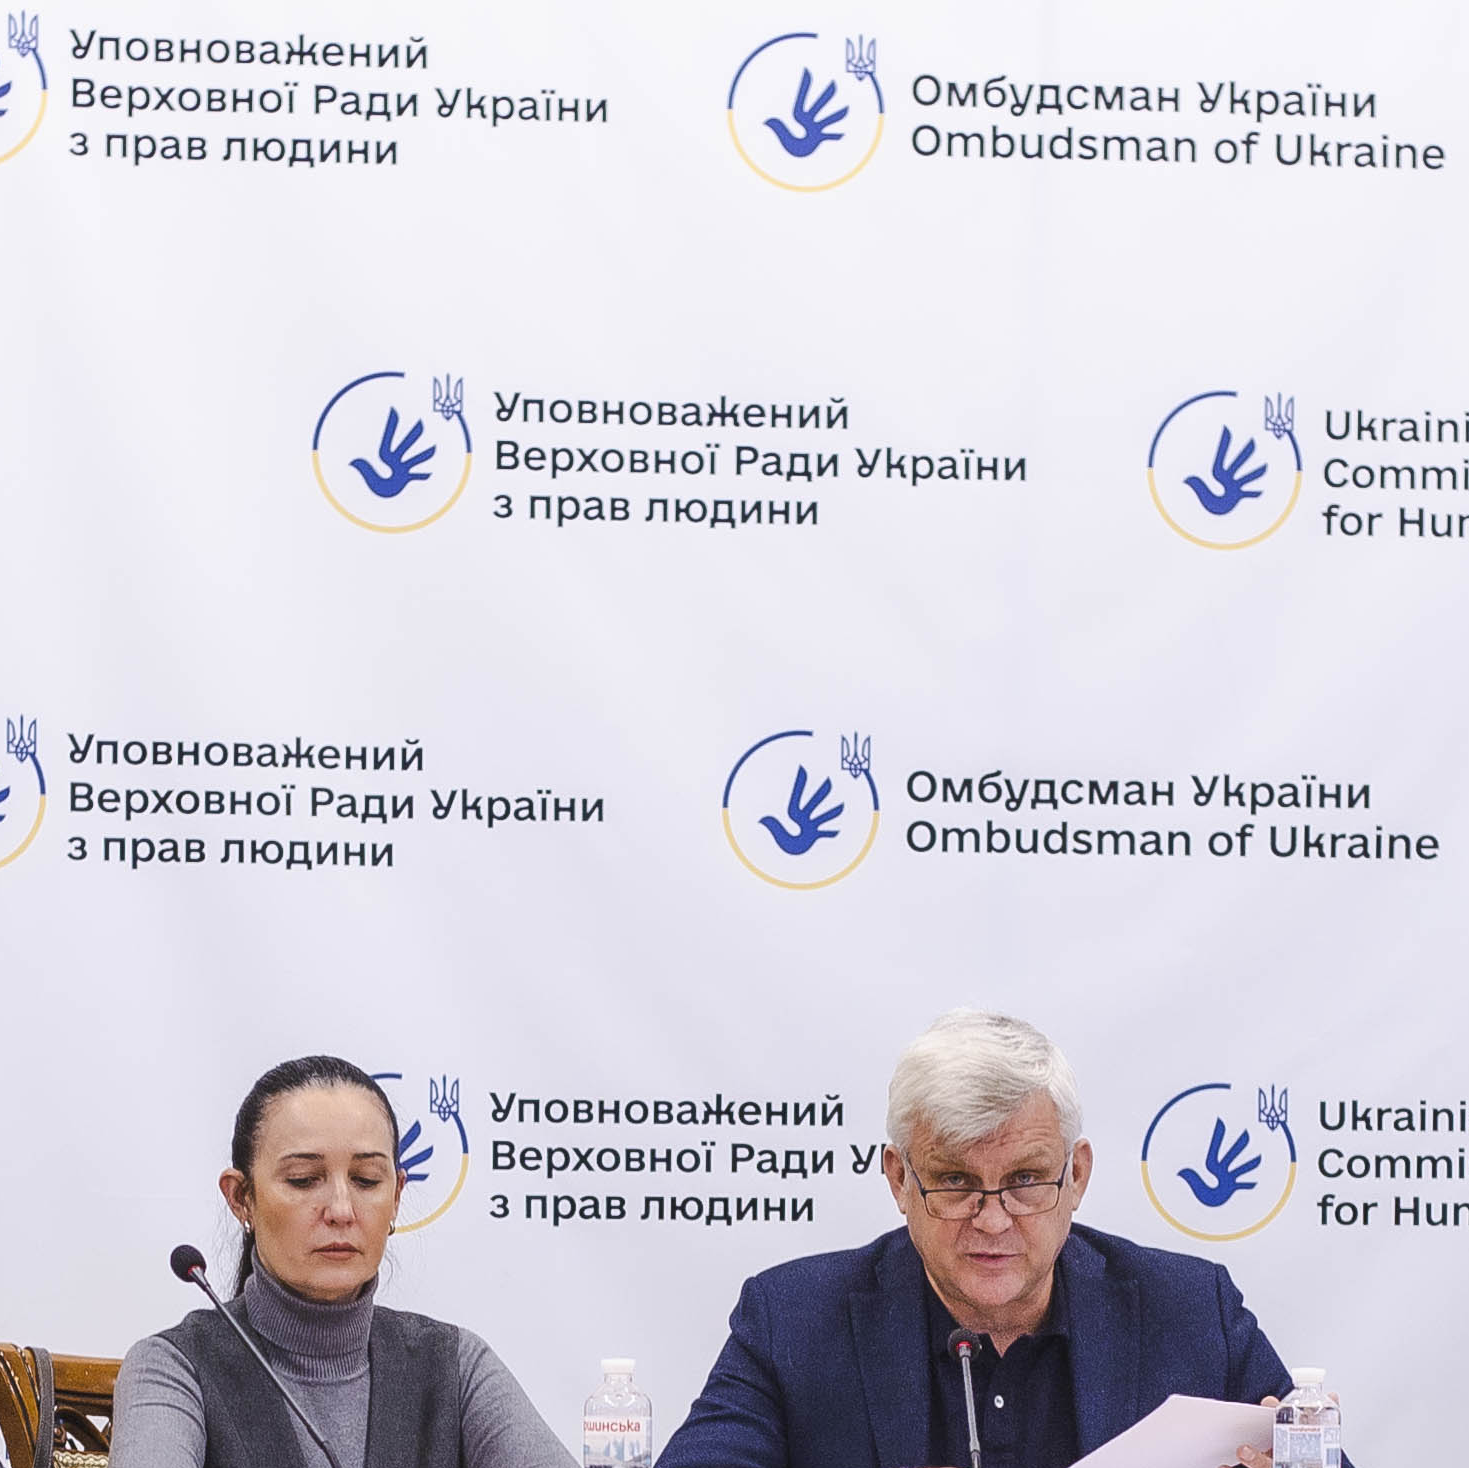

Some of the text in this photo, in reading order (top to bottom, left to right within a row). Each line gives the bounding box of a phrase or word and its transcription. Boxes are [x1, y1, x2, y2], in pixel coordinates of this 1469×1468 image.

[70, 30, 426, 68] Уповноважений
[73, 79, 607, 127] Верховної Ради України
[913, 75, 1376, 122] Омбудсман України
[70, 133, 396, 168] з прав людини
[912, 125, 1444, 169] Ombudsman of Ukraine
[494, 392, 848, 429] Уповноважений
[497, 441, 1026, 486] Верховної Ради України
[494, 495, 818, 529] з прав людини
[1322, 505, 1382, 537] for
[68, 734, 424, 772] Уповноважений
[71, 782, 604, 828] Верховної Ради України
[907, 770, 1370, 815] Омбудсман України
[68, 837, 394, 871] з прав людини
[907, 819, 1440, 860] Ombudsman of Ukraine
[490, 1093, 843, 1127] Уповноважений
[493, 1141, 712, 1179] Верховної
[731, 1142, 834, 1180] Ради
[490, 1195, 814, 1228] з прав людини
[1317, 1194, 1378, 1225] for
